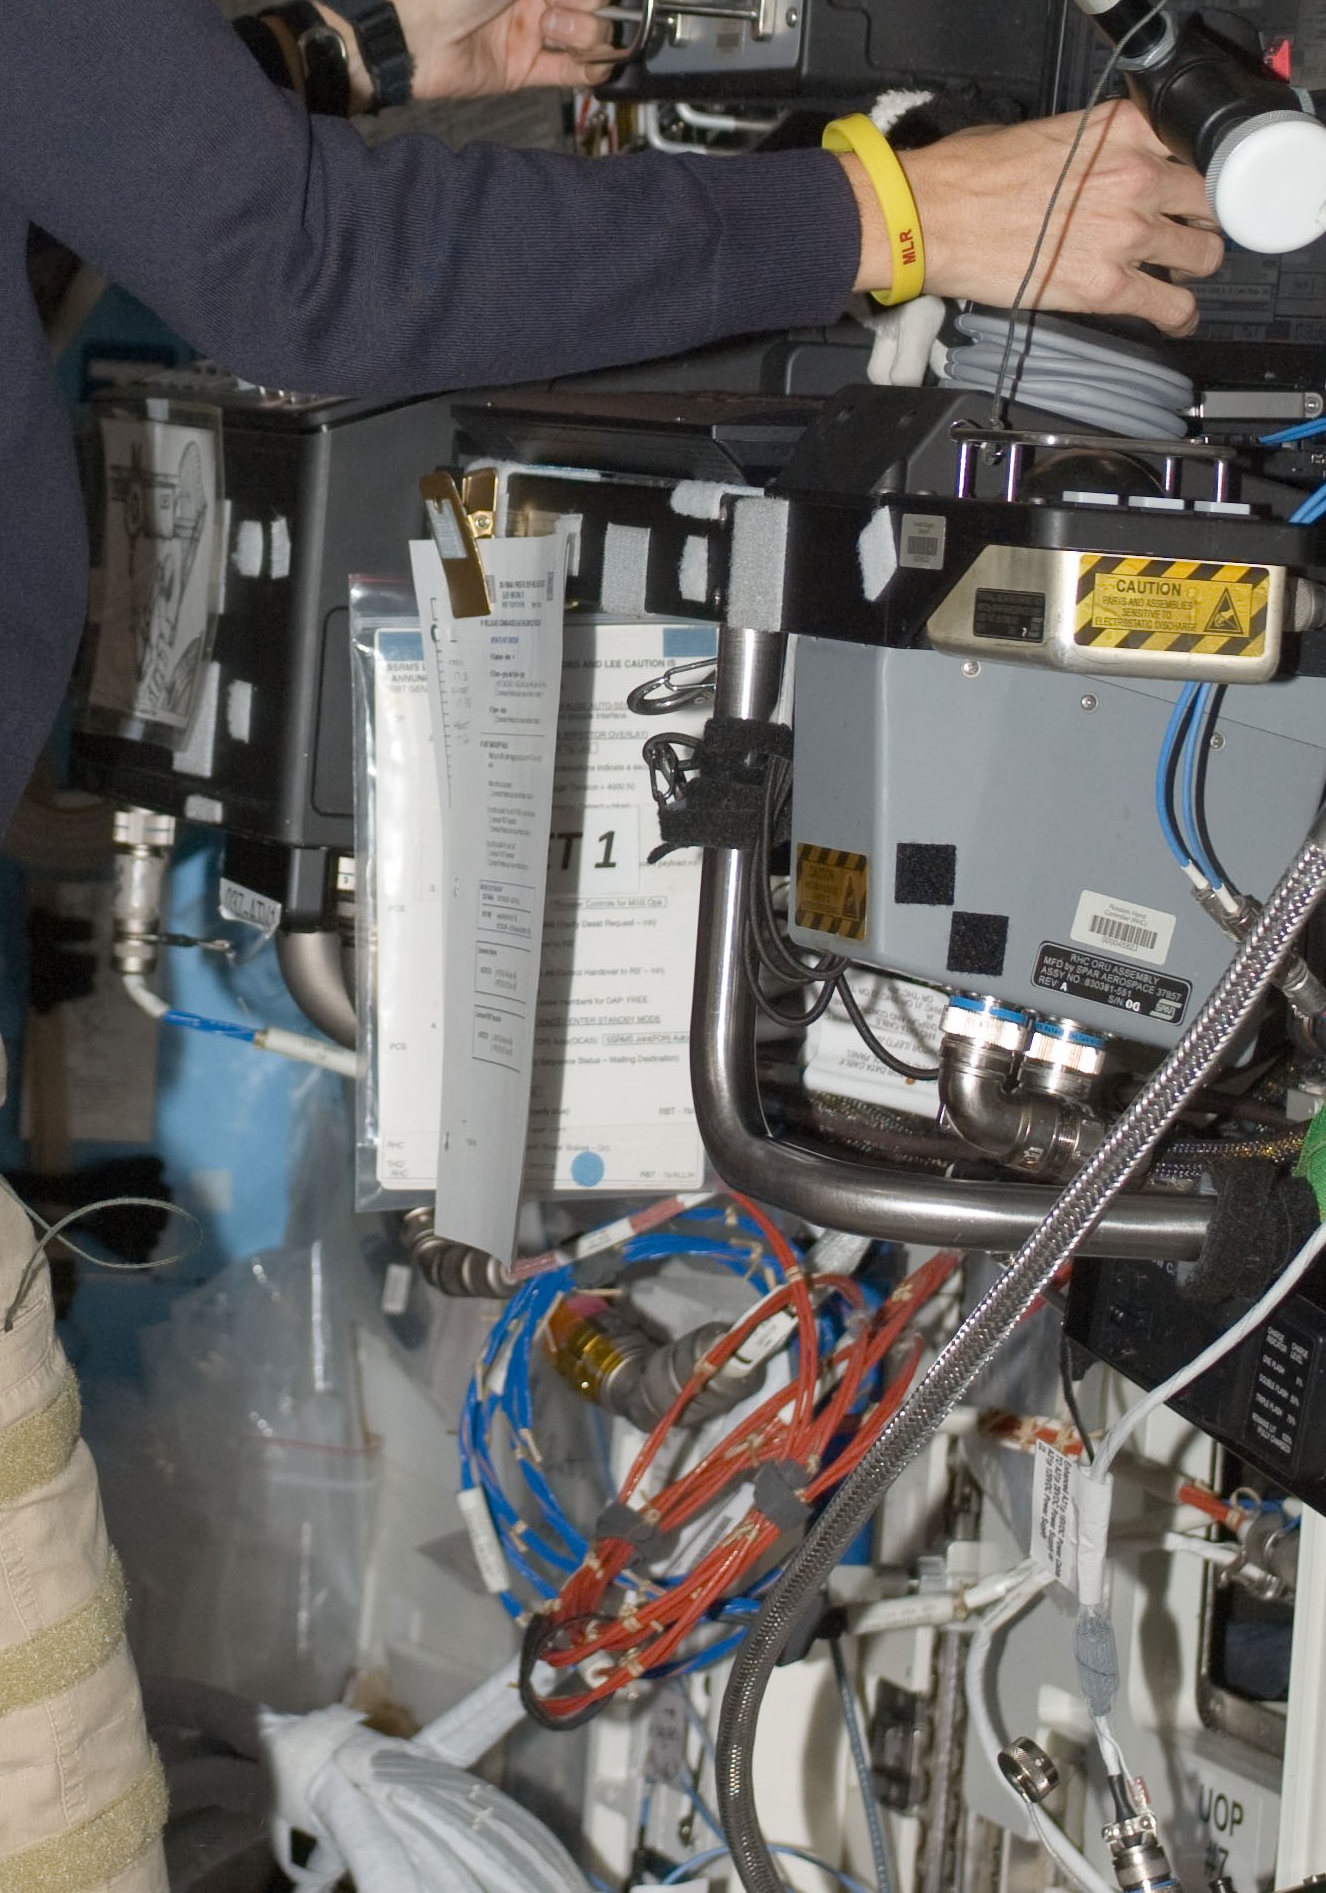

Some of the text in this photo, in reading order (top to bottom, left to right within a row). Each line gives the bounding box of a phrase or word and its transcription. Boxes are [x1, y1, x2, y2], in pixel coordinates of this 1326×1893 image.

[899, 228, 917, 266] MLR
[1116, 578, 1182, 597] CAUTION
[1102, 595, 1194, 610] PARTS AND ASSEMBLIES
[1095, 616, 1198, 632] ELECTROSTATIC DISCHARGE
[1122, 608, 1172, 620] SENSITIVE TO
[387, 663, 420, 672] SSRMS
[582, 659, 602, 669] AND
[604, 659, 622, 669] LEE
[624, 658, 665, 669] CAUTION
[550, 830, 616, 870] T 1
[1040, 967, 1065, 981] ASSY
[1043, 955, 1064, 968] MFD
[1065, 962, 1075, 974] by
[1076, 964, 1100, 979] SPAR
[1102, 972, 1155, 994] AEROSPACE
[1070, 953, 1161, 985] RHC ORU ASSEMBLY
[1059, 981, 1068, 992] A
[1155, 1001, 1177, 1017] SPAR
[1041, 1493, 1052, 1516] Power
[1039, 1514, 1050, 1540] Supply
[1049, 1509, 1059, 1531] Power
[1047, 1530, 1057, 1554] Supply
[1055, 1538, 1064, 1559] Power
[1197, 1783, 1245, 1837] UOP
